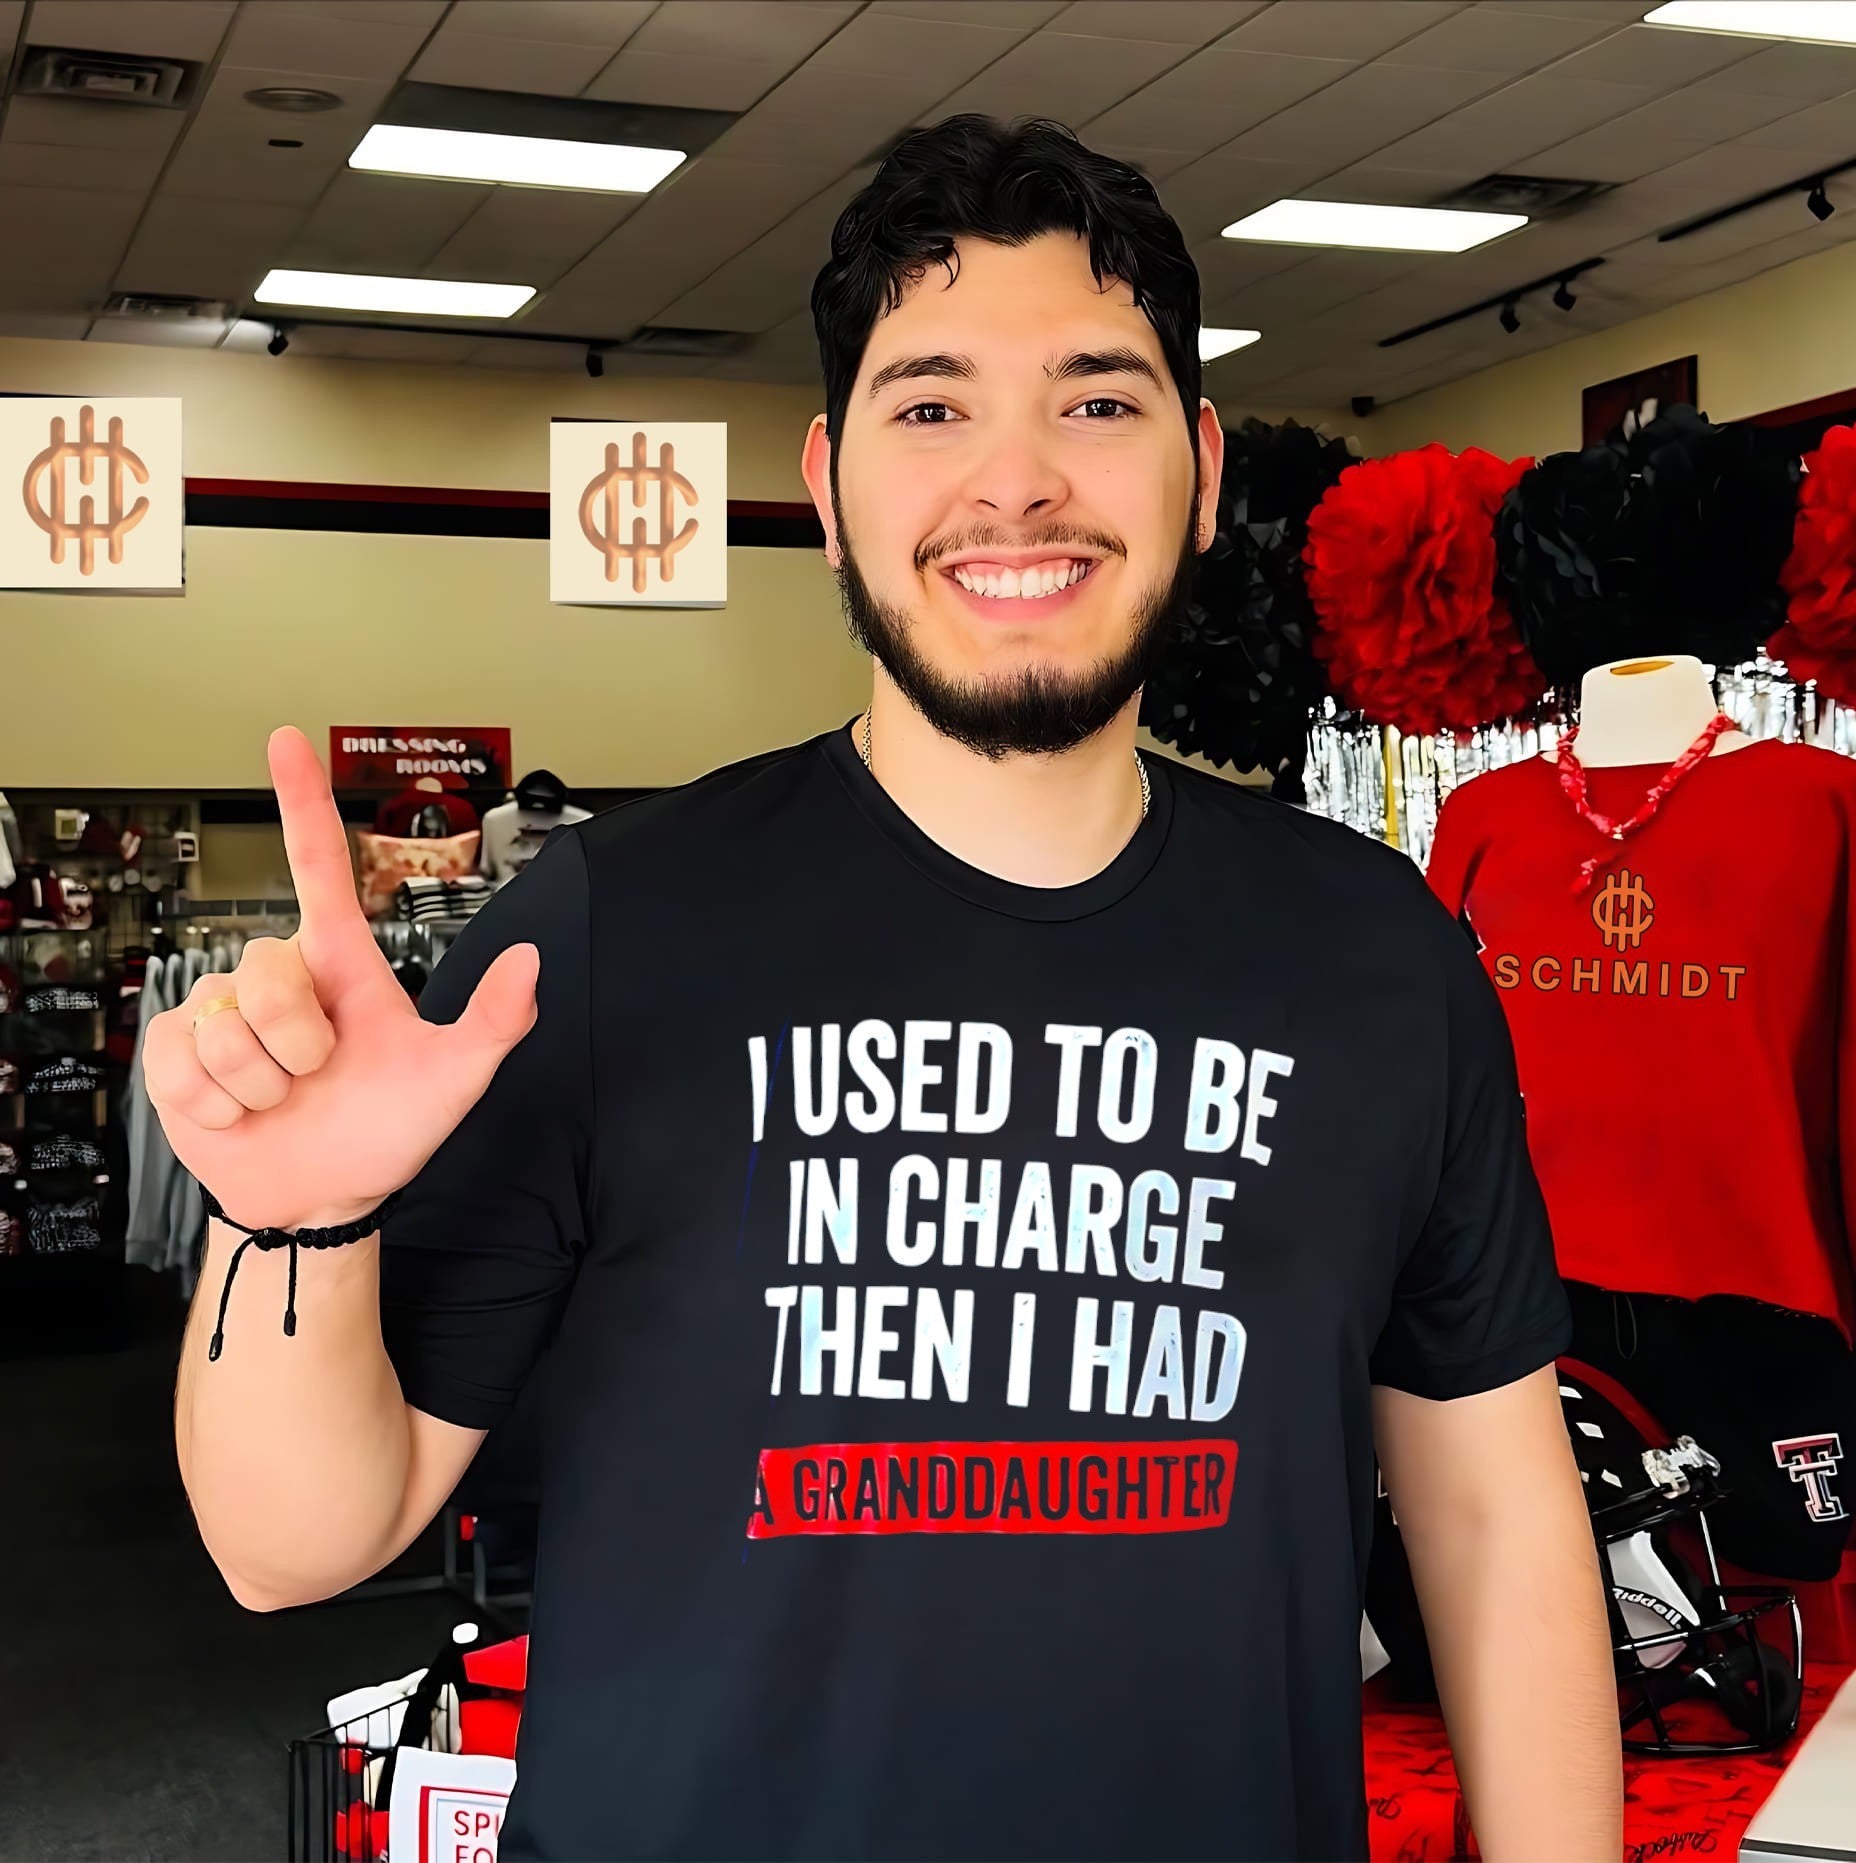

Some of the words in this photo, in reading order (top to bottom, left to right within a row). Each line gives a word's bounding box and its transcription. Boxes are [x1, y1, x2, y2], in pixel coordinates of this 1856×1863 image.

[396, 758, 487, 775] ROOMS
[1494, 954, 1746, 1000] SCHMIDT
[748, 1035, 768, 1143] I
[792, 1018, 1014, 1137] USED
[1044, 1023, 1159, 1144] TO
[1184, 1036, 1295, 1167] BE
[787, 1157, 859, 1266] IN
[886, 1154, 1237, 1290] CHARGE
[764, 1285, 975, 1404] THEN
[1006, 1292, 1037, 1408] I
[1069, 1296, 1248, 1423] HAD
[750, 1460, 775, 1526] A
[793, 1452, 1227, 1522] GRANDDAUGHTER
